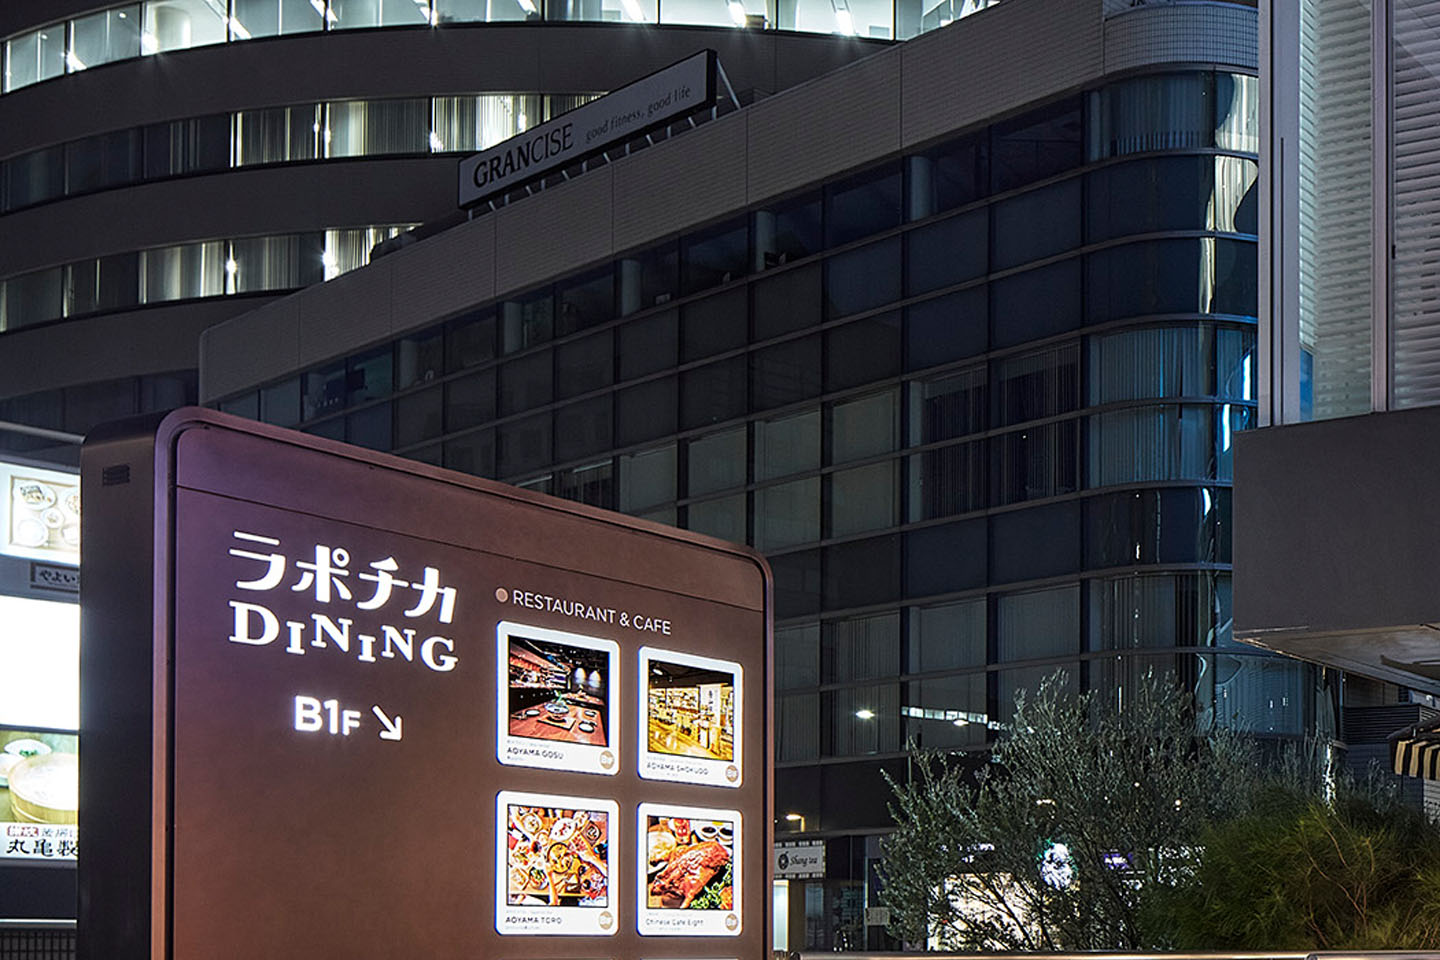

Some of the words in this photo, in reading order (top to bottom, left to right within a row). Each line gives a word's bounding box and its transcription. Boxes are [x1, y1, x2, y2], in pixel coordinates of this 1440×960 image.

[473, 122, 574, 188] GRANCISE
[587, 119, 609, 144] good
[609, 111, 646, 131] fitness,
[647, 96, 671, 117] good
[673, 85, 691, 104] life
[39, 569, 79, 583] やよい
[229, 530, 458, 624] ラポチカ
[512, 589, 616, 624] RESTAURANT
[619, 611, 631, 627] &
[632, 615, 672, 635] CAFE
[229, 600, 459, 672] DINING
[294, 695, 362, 736] B1F
[507, 746, 540, 757] AOYAMA
[506, 916, 539, 924] AOYAMA
